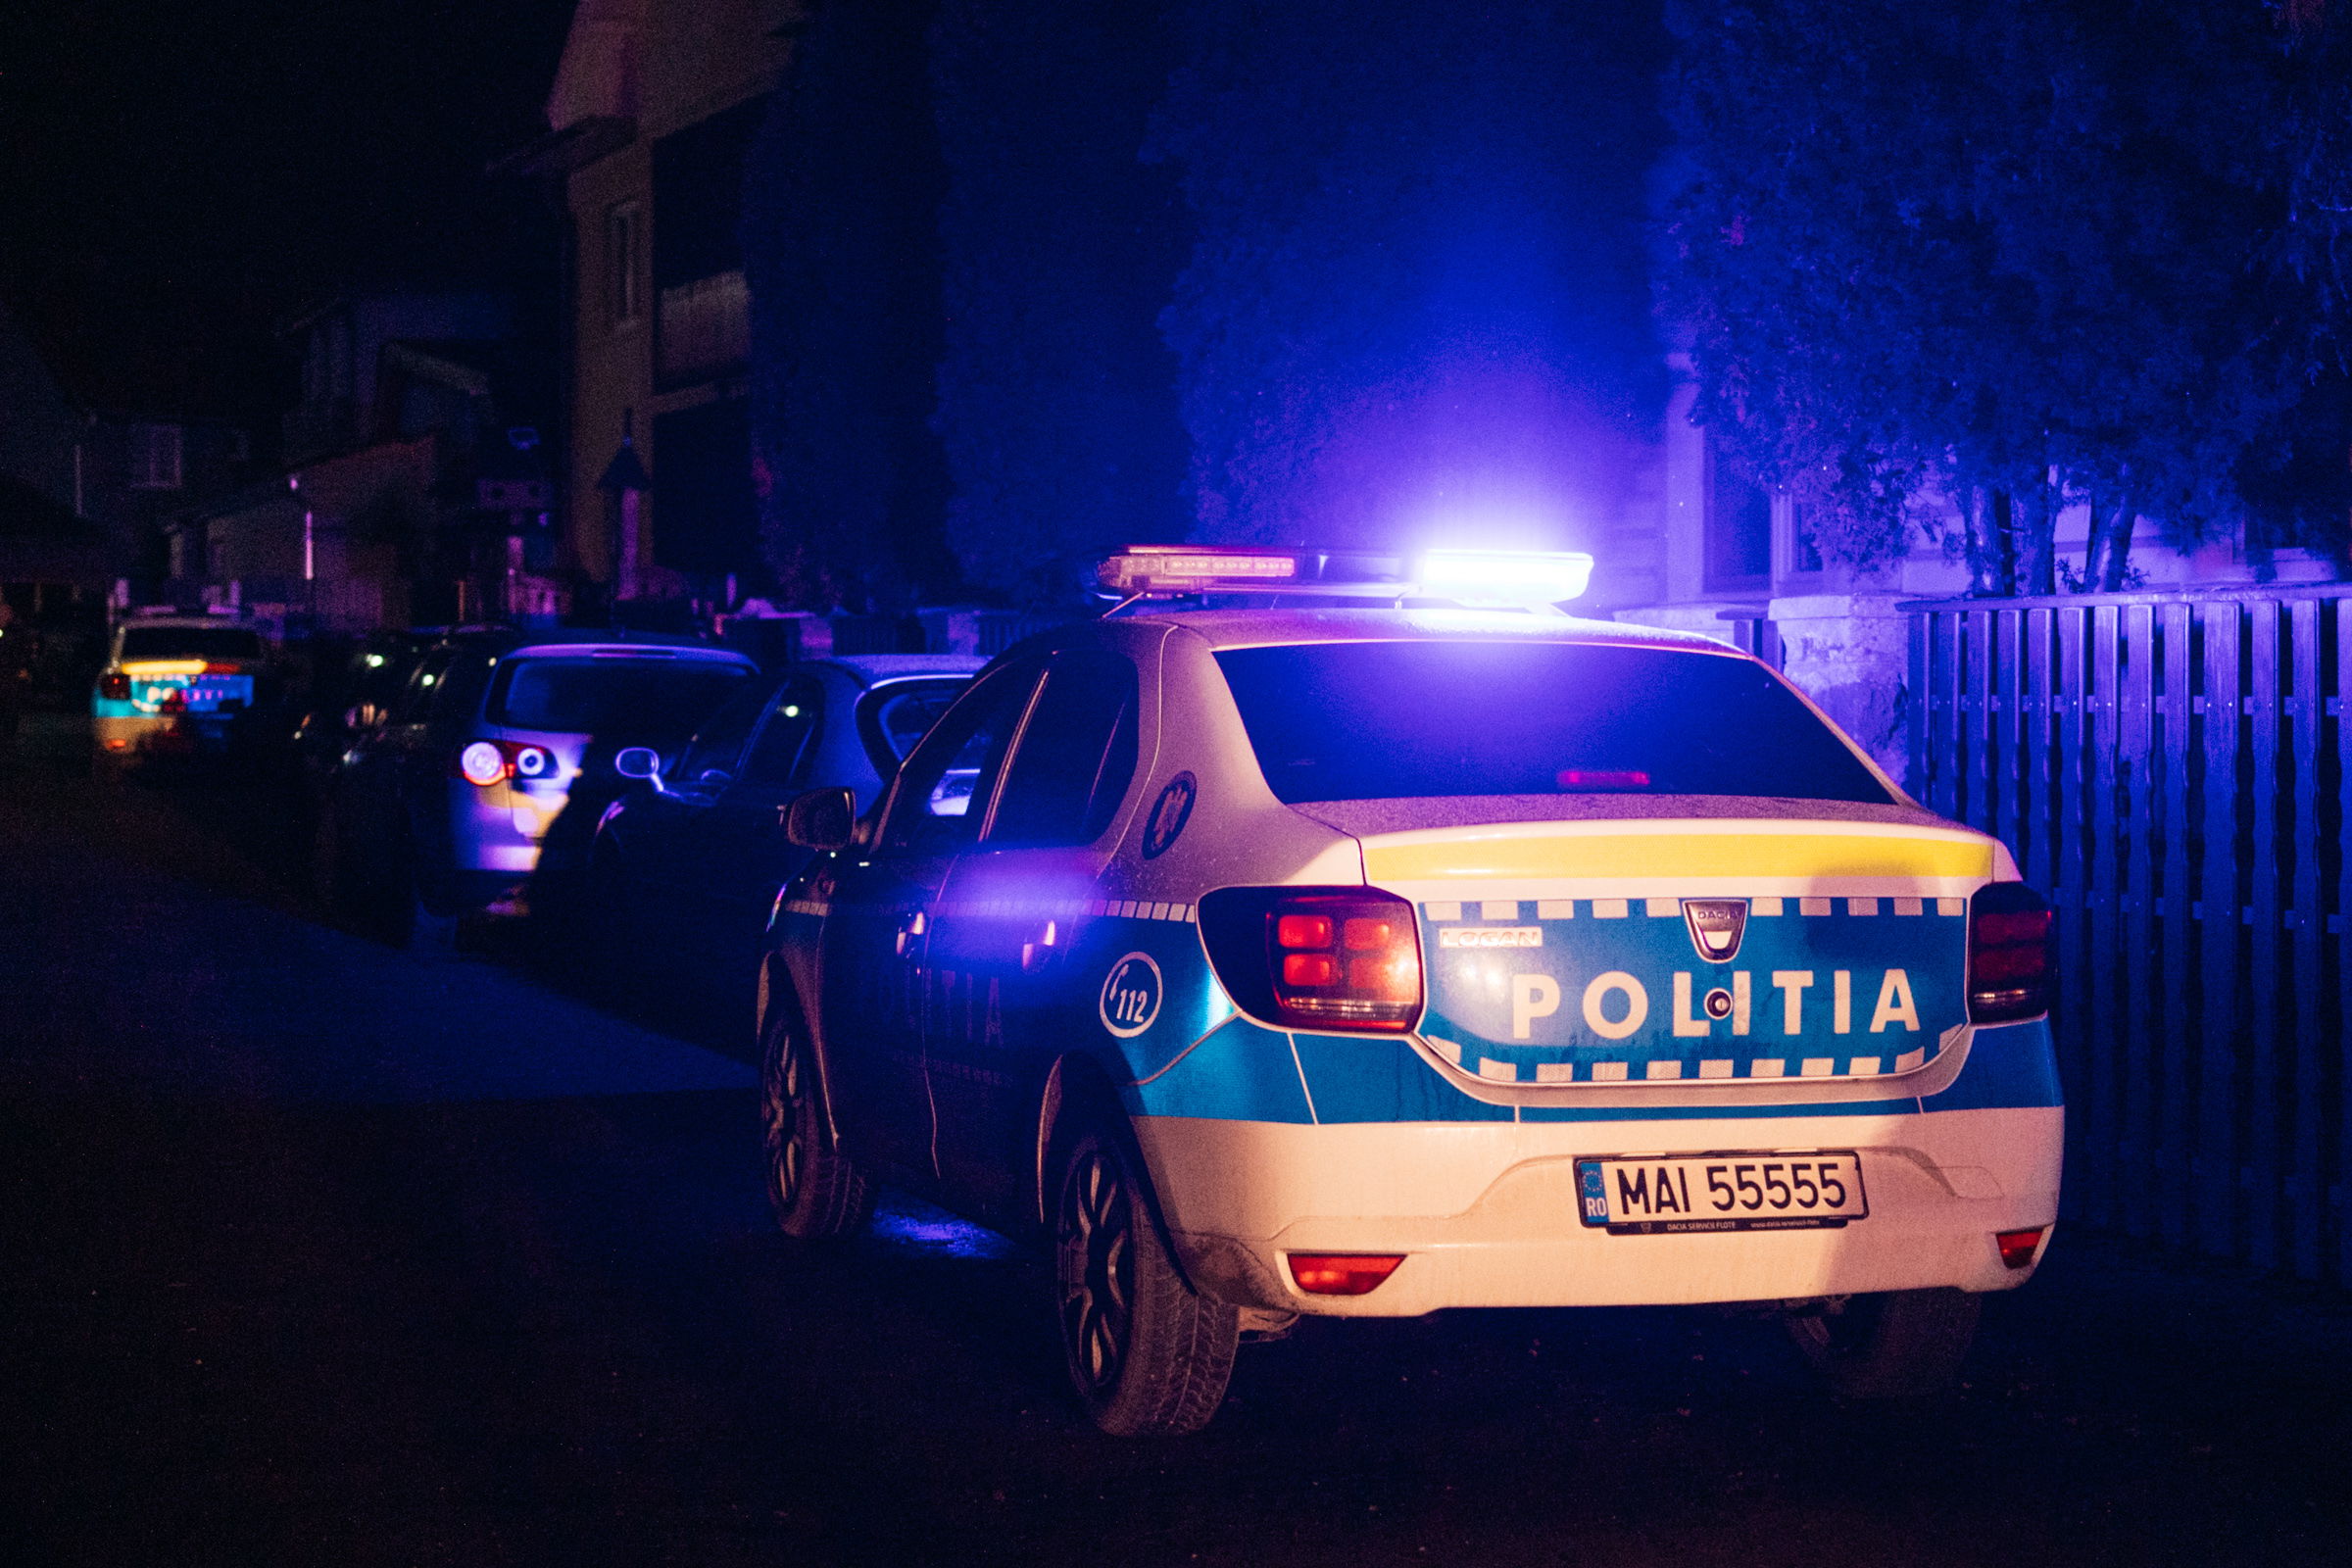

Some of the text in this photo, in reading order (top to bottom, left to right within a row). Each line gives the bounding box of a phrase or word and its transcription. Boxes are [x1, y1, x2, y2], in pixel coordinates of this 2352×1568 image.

[1697, 910, 1740, 919] DACIA
[1441, 931, 1540, 948] LOGAN
[1116, 988, 1149, 1024] 112
[1511, 968, 1921, 1040] POLITIA
[1617, 1162, 1846, 1215] MAI 55555
[1586, 1197, 1607, 1217] RO
